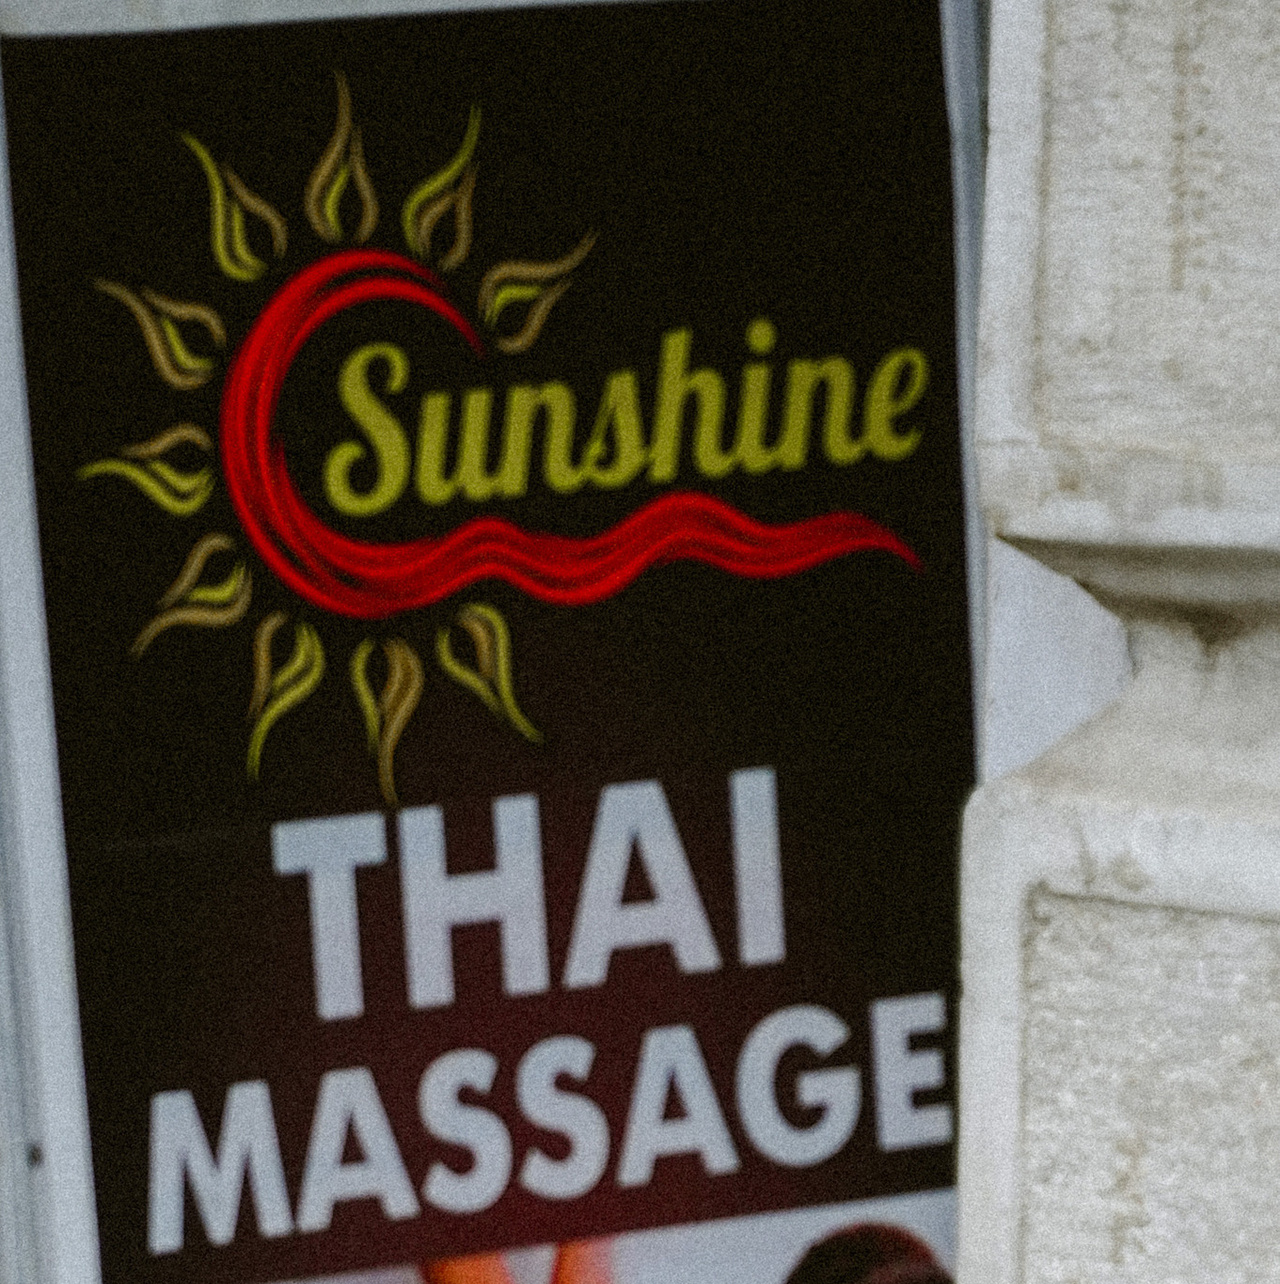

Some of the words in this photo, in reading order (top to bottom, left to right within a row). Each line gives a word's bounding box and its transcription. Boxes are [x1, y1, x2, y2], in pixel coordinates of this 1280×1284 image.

[324, 317, 927, 516] Sunshine
[271, 767, 785, 1021] THAI
[147, 992, 955, 1256] MASSAGE
